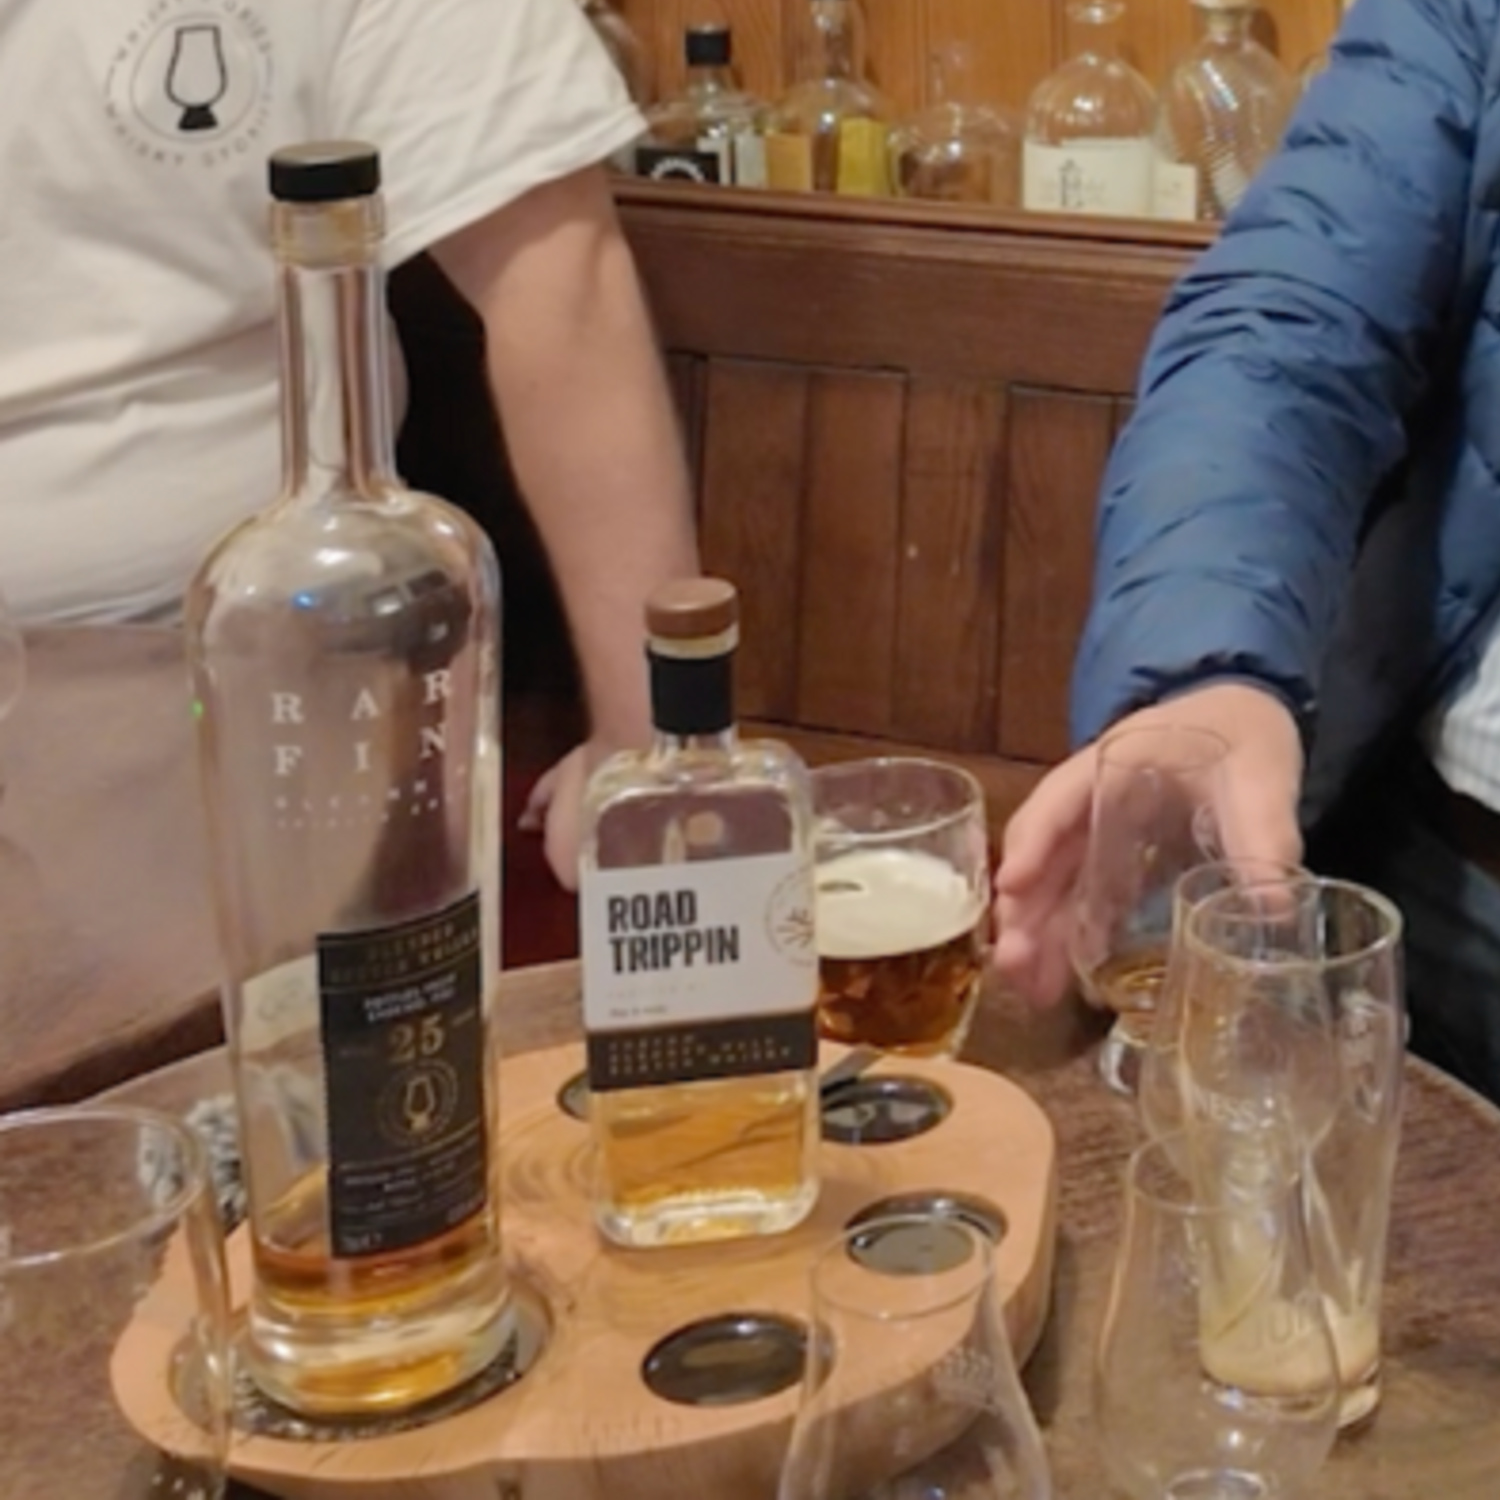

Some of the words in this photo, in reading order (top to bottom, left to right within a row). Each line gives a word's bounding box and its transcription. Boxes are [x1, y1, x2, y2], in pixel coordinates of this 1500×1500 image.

[607, 889, 698, 934] ROAD
[609, 925, 740, 975] TRIPPIN
[387, 1014, 445, 1065] 25
